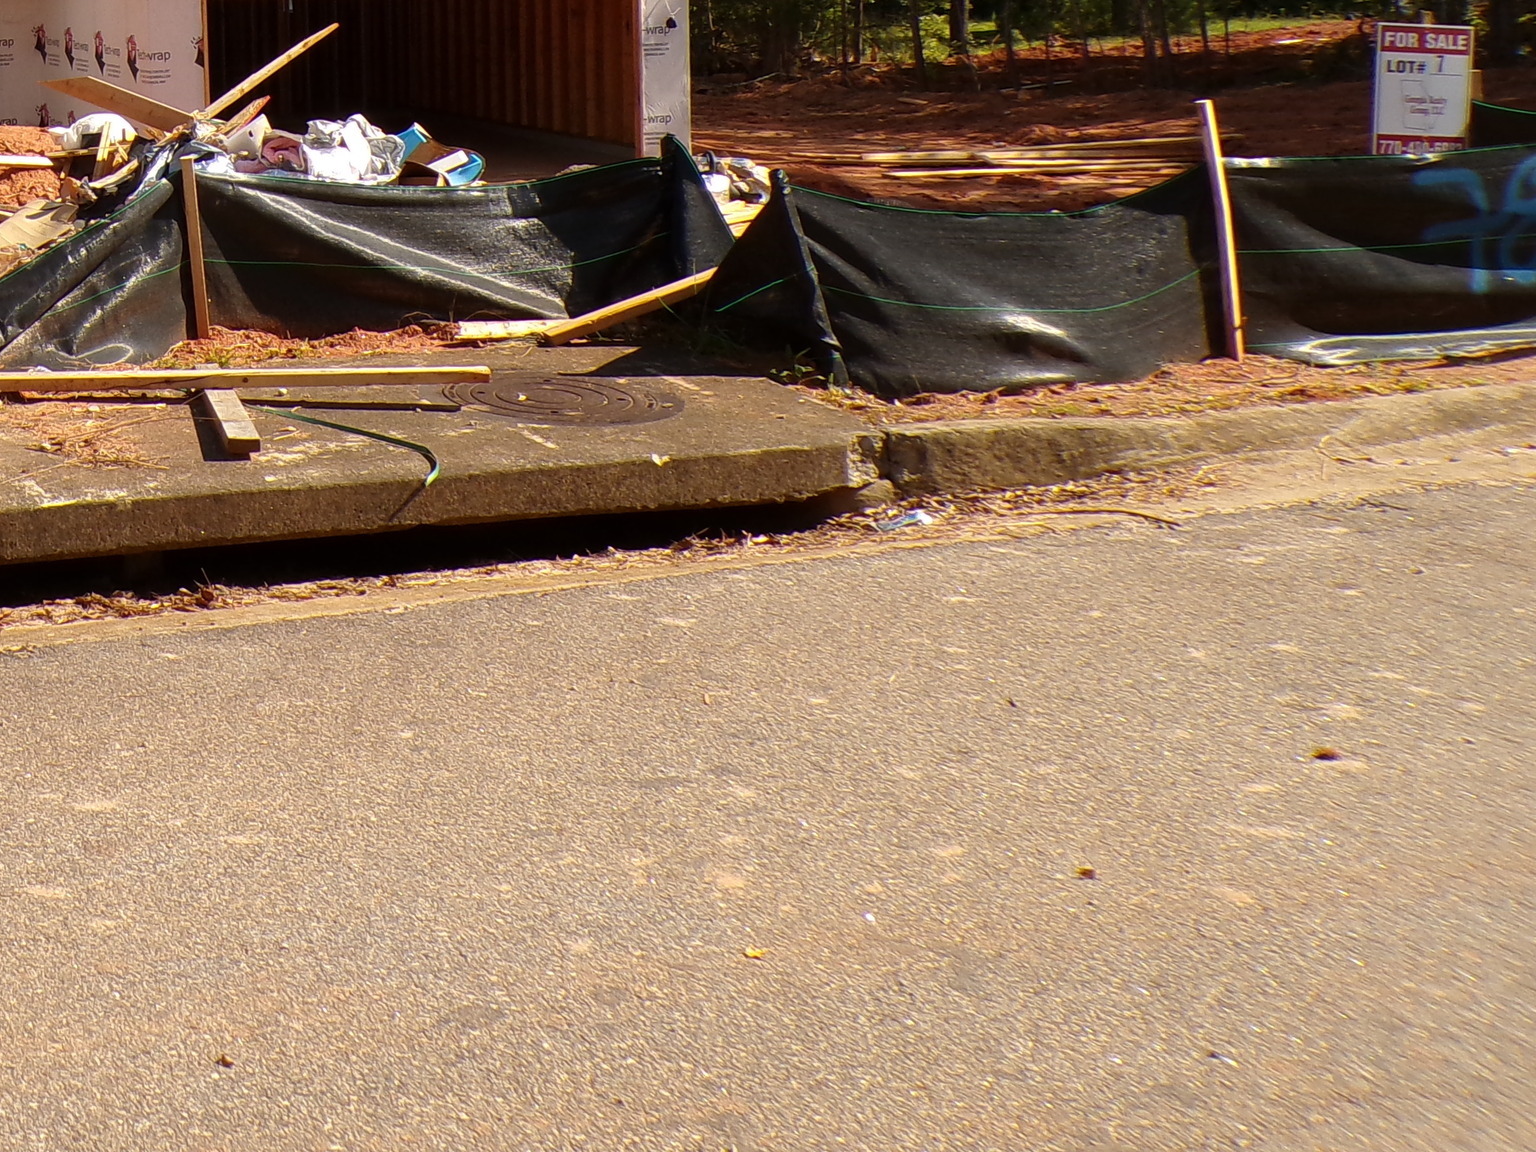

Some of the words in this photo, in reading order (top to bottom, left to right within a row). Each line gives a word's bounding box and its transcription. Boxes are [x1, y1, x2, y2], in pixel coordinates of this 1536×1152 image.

[1384, 32, 1419, 48] FOR
[1426, 34, 1469, 50] SALE
[1387, 60, 1427, 74] LOT#
[1436, 56, 1444, 72] 7
